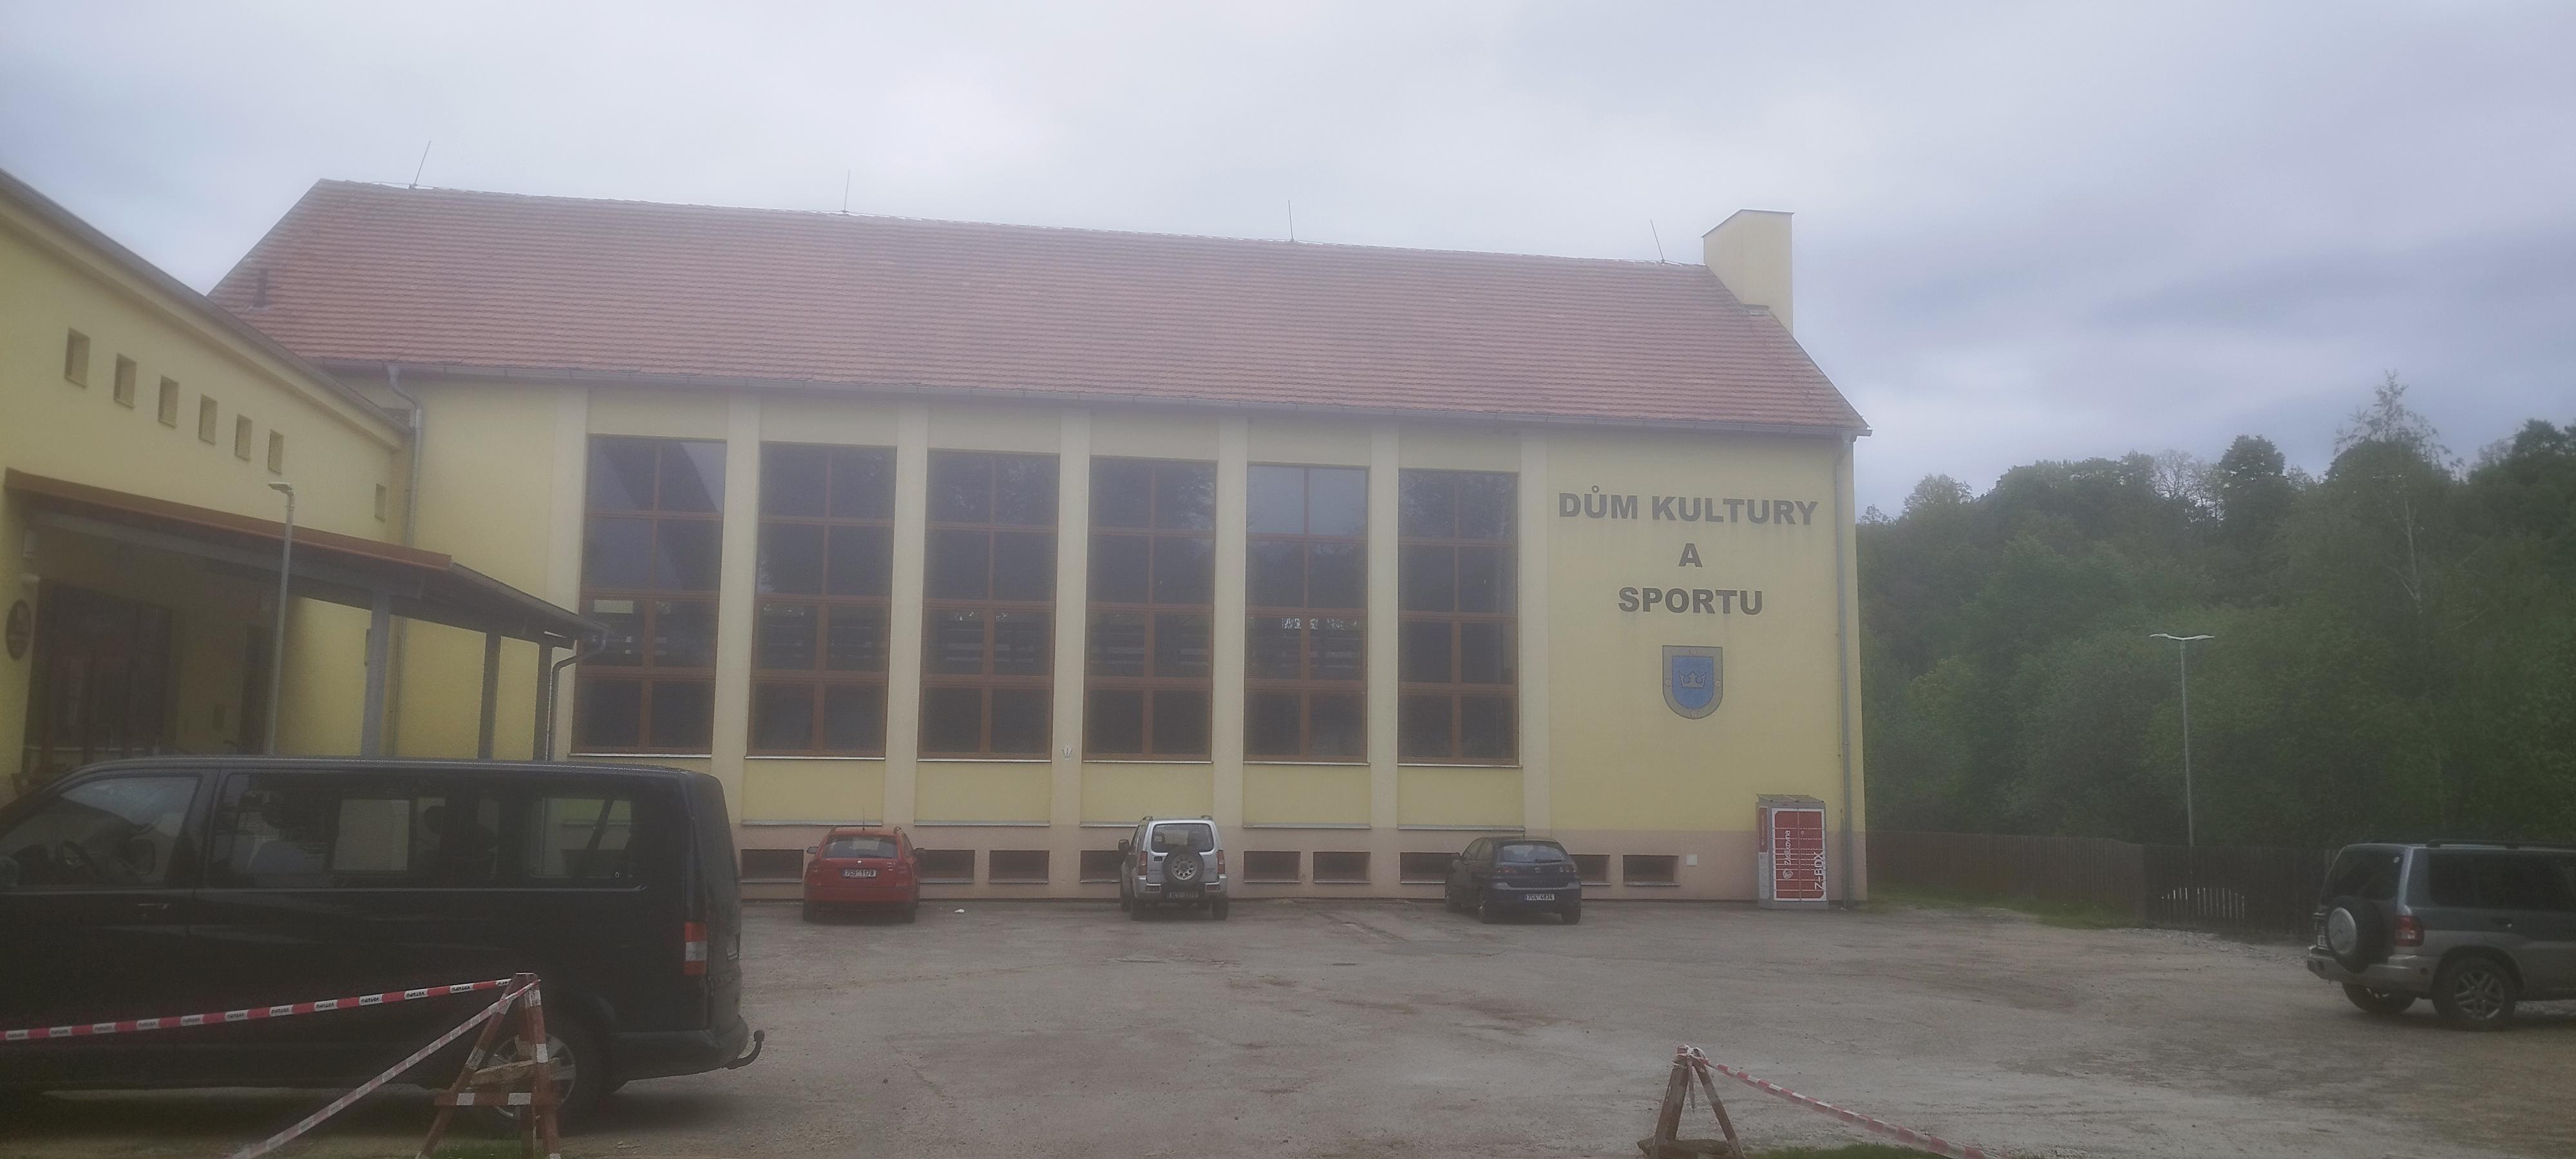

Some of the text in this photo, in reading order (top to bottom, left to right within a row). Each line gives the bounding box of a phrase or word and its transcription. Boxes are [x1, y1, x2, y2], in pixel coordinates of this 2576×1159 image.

[1558, 485, 1818, 525] DŮM KULTURY
[1678, 543, 1703, 567] A
[1618, 587, 1763, 615] SPORTU
[1814, 851, 1824, 890] Z-BOX
